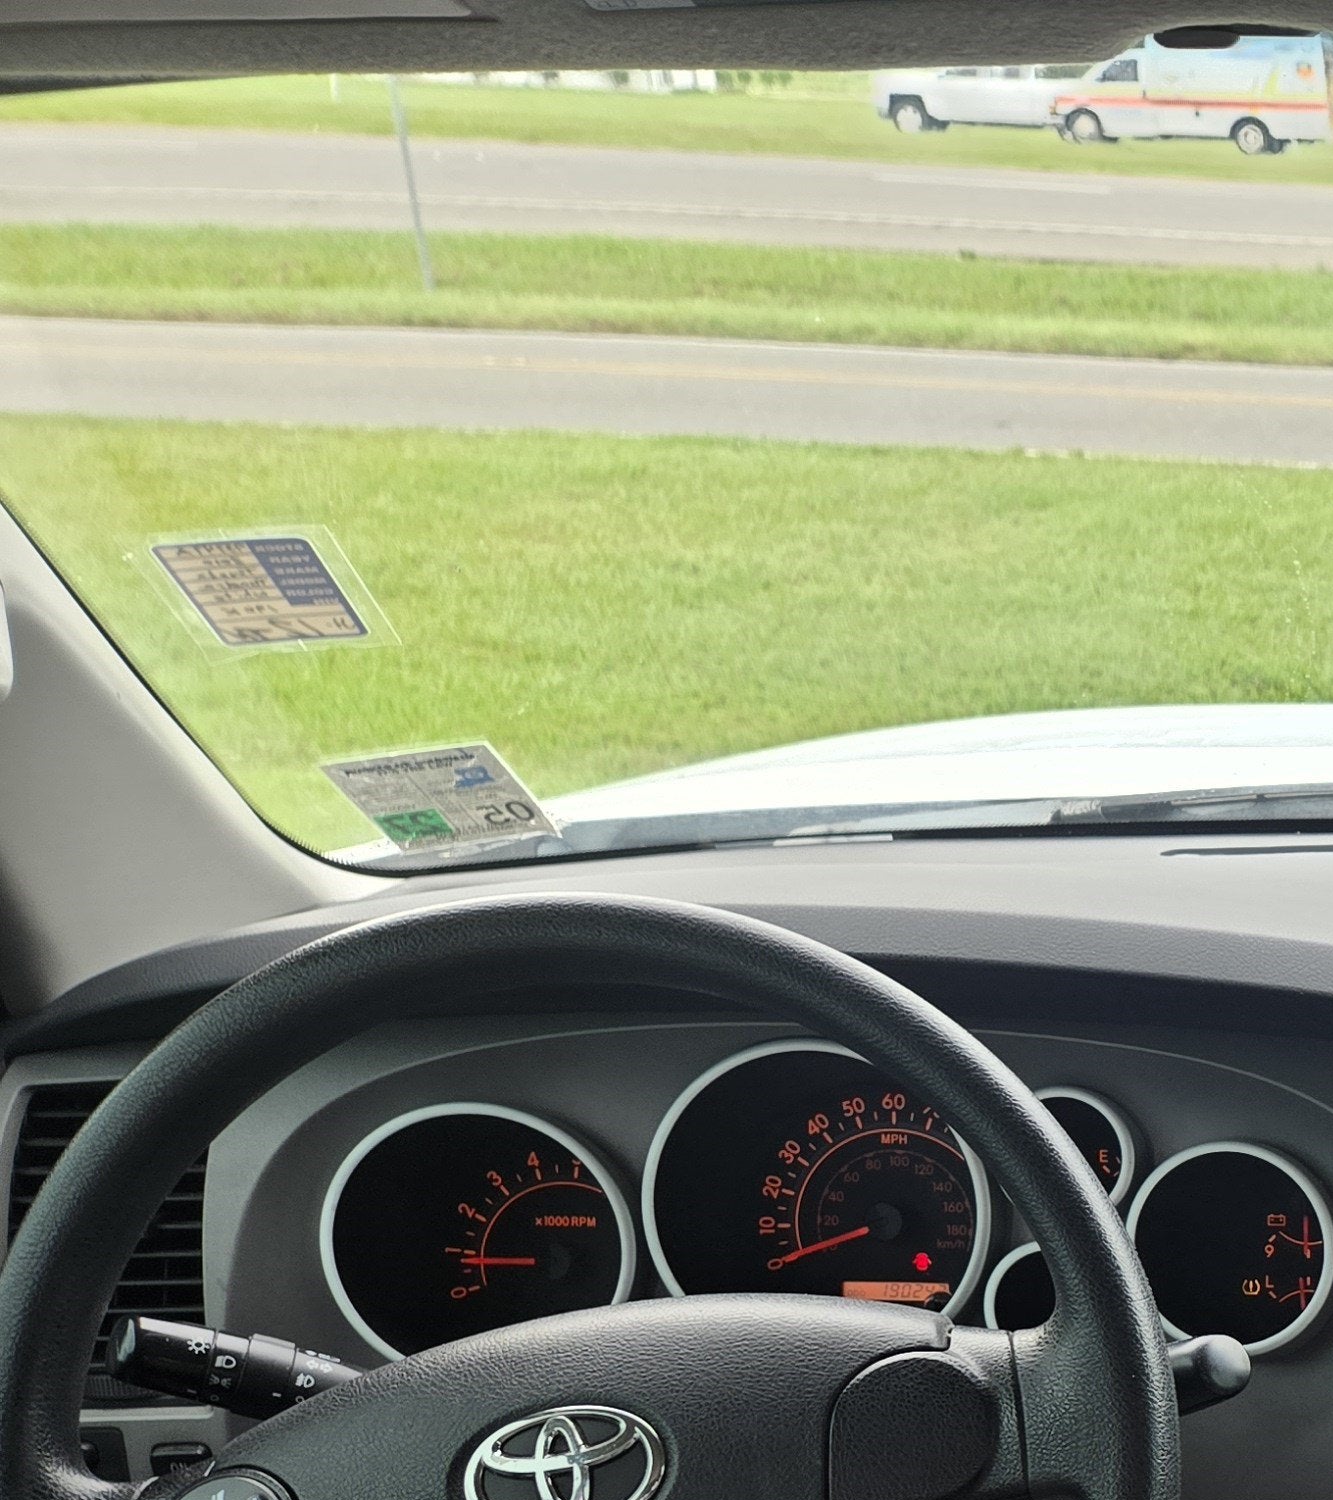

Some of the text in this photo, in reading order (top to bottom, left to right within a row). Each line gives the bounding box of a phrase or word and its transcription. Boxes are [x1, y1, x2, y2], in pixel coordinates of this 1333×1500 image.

[842, 1097, 865, 1117] 50
[881, 1093, 906, 1110] 60
[806, 1113, 829, 1136] 40
[880, 1134, 908, 1145] MPH
[527, 1151, 539, 1167] 4
[778, 1140, 801, 1164] 30
[1099, 1149, 1109, 1163] E
[486, 1170, 502, 1186] 3
[762, 1175, 782, 1199] 20
[457, 1202, 475, 1219] 2
[571, 1216, 597, 1228] RPM
[759, 1216, 776, 1235] 10
[767, 1258, 783, 1271] 0
[1265, 1275, 1274, 1288] L
[451, 1286, 467, 1299] 0
